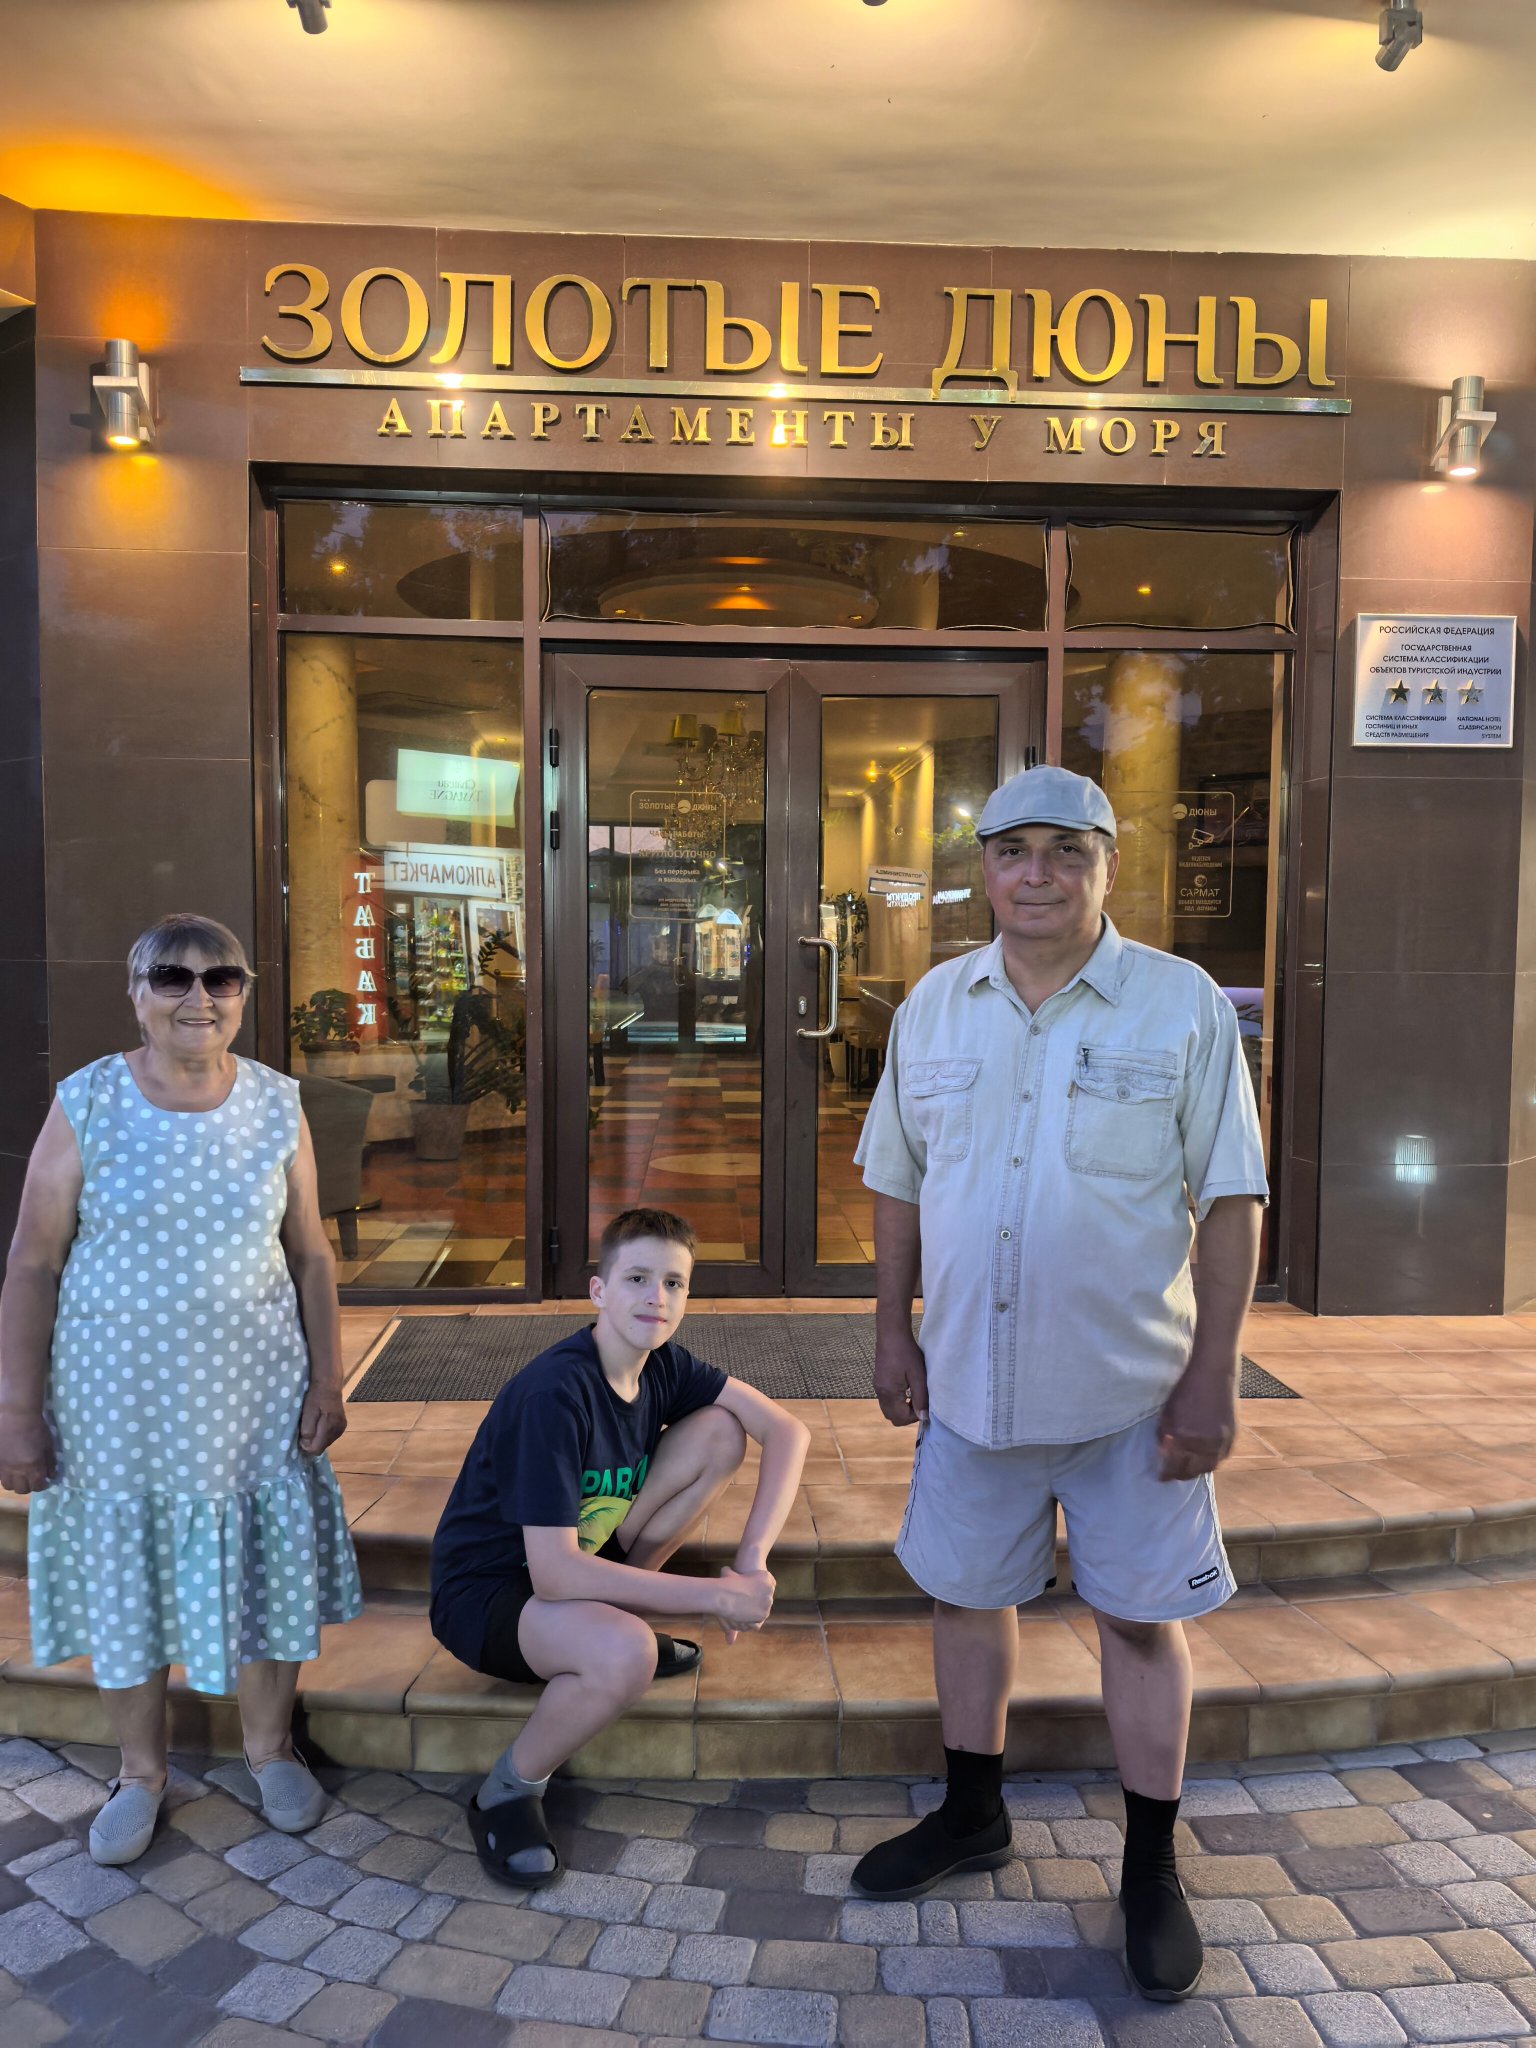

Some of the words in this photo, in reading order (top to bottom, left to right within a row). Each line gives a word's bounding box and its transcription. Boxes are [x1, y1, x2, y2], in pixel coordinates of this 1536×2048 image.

[261, 263, 884, 375] ЗОЛОТЫЕ
[931, 286, 1336, 402] ДЮНЫ
[377, 397, 915, 450] АПАРТАМЕНТЫ
[970, 414, 1002, 449] У
[1045, 416, 1228, 457] МОРЯ
[1379, 625, 1441, 635] РОССИЙСКАЯ
[1443, 627, 1495, 636] ФЕДЕРАЦИЯ
[1401, 644, 1472, 652] ГОСУДАРСТВЕННАЯ
[1383, 655, 1419, 663] СИСТЕМА
[1420, 656, 1489, 664] КЛАССИФИКАЦИИ
[1369, 666, 1407, 674] ОБЪЕКТОВ
[1408, 667, 1456, 675] ТУРИСТСКОЙ
[1457, 668, 1502, 676] ИНДУСТРИИ
[1188, 808, 1217, 817] ДЮНЫ
[1180, 888, 1221, 897] САРМАТ
